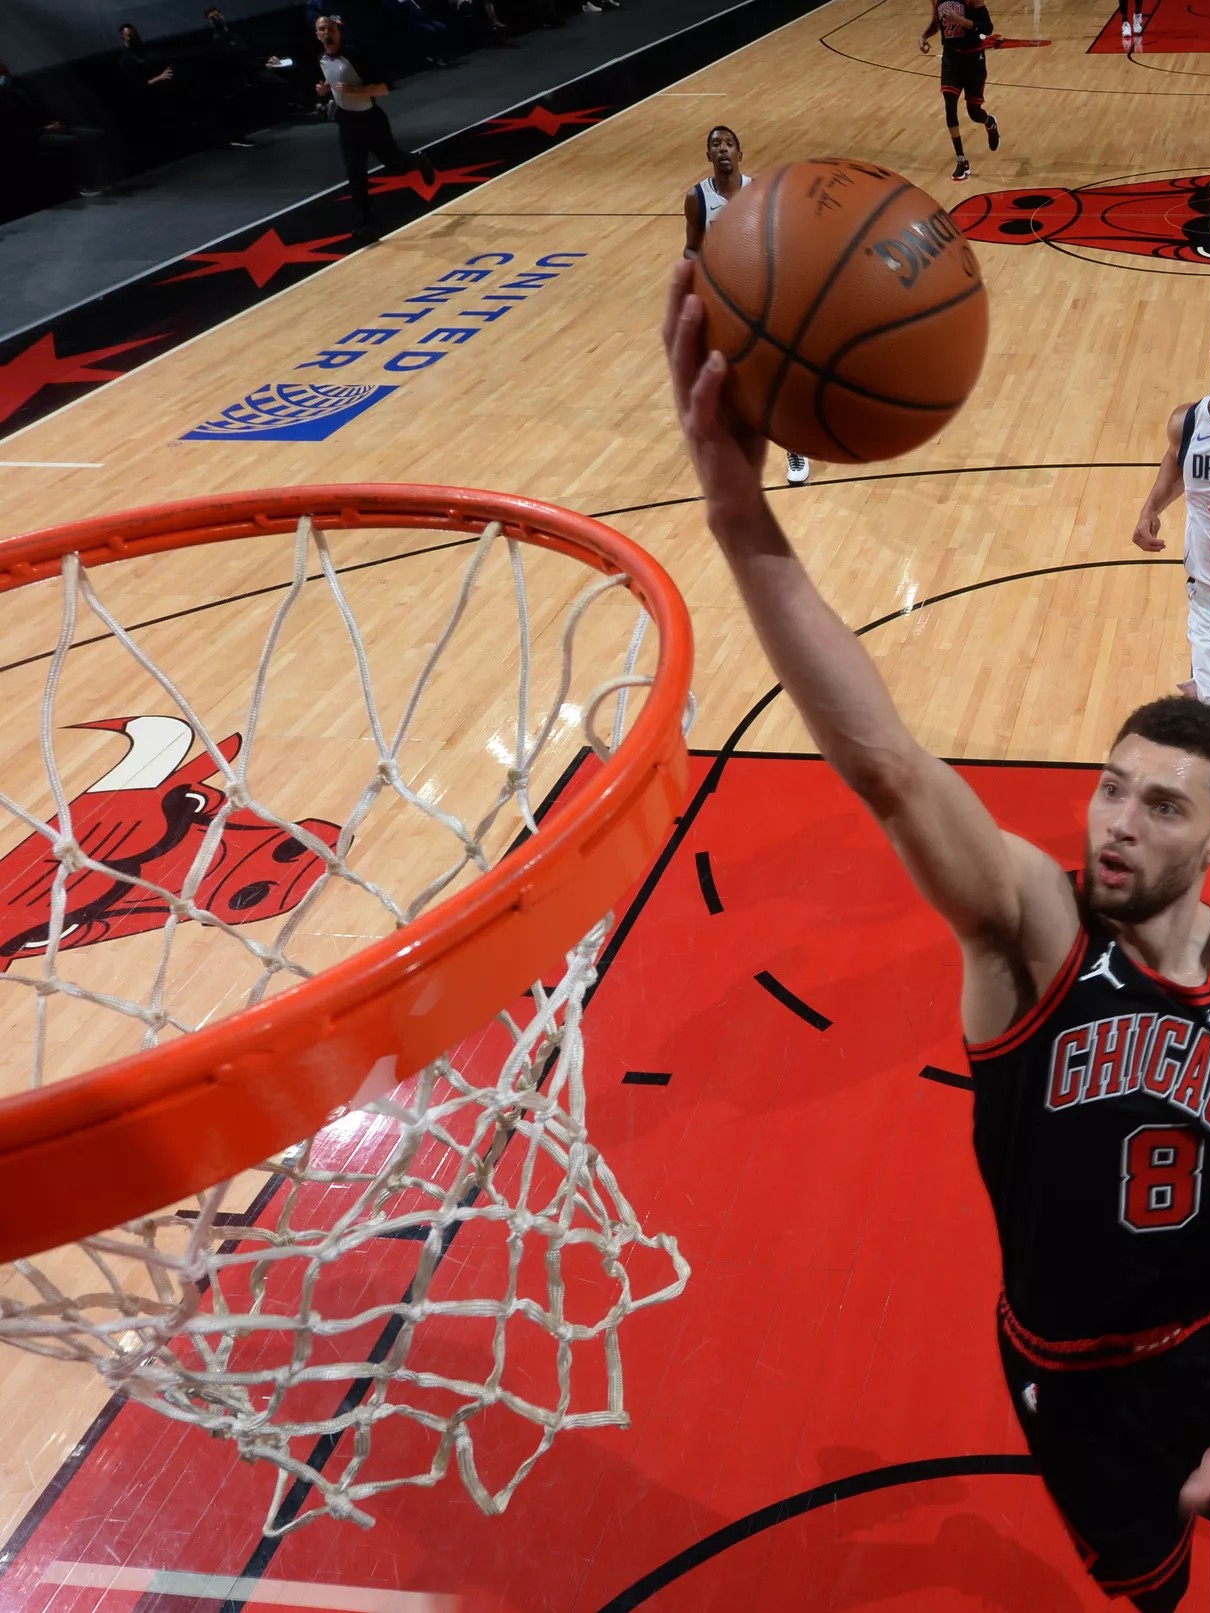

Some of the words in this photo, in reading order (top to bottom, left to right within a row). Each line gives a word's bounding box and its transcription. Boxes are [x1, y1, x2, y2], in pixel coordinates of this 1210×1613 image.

[293, 252, 515, 370] CENTER
[383, 252, 590, 372] UNITED
[1118, 1123, 1204, 1234] 8
